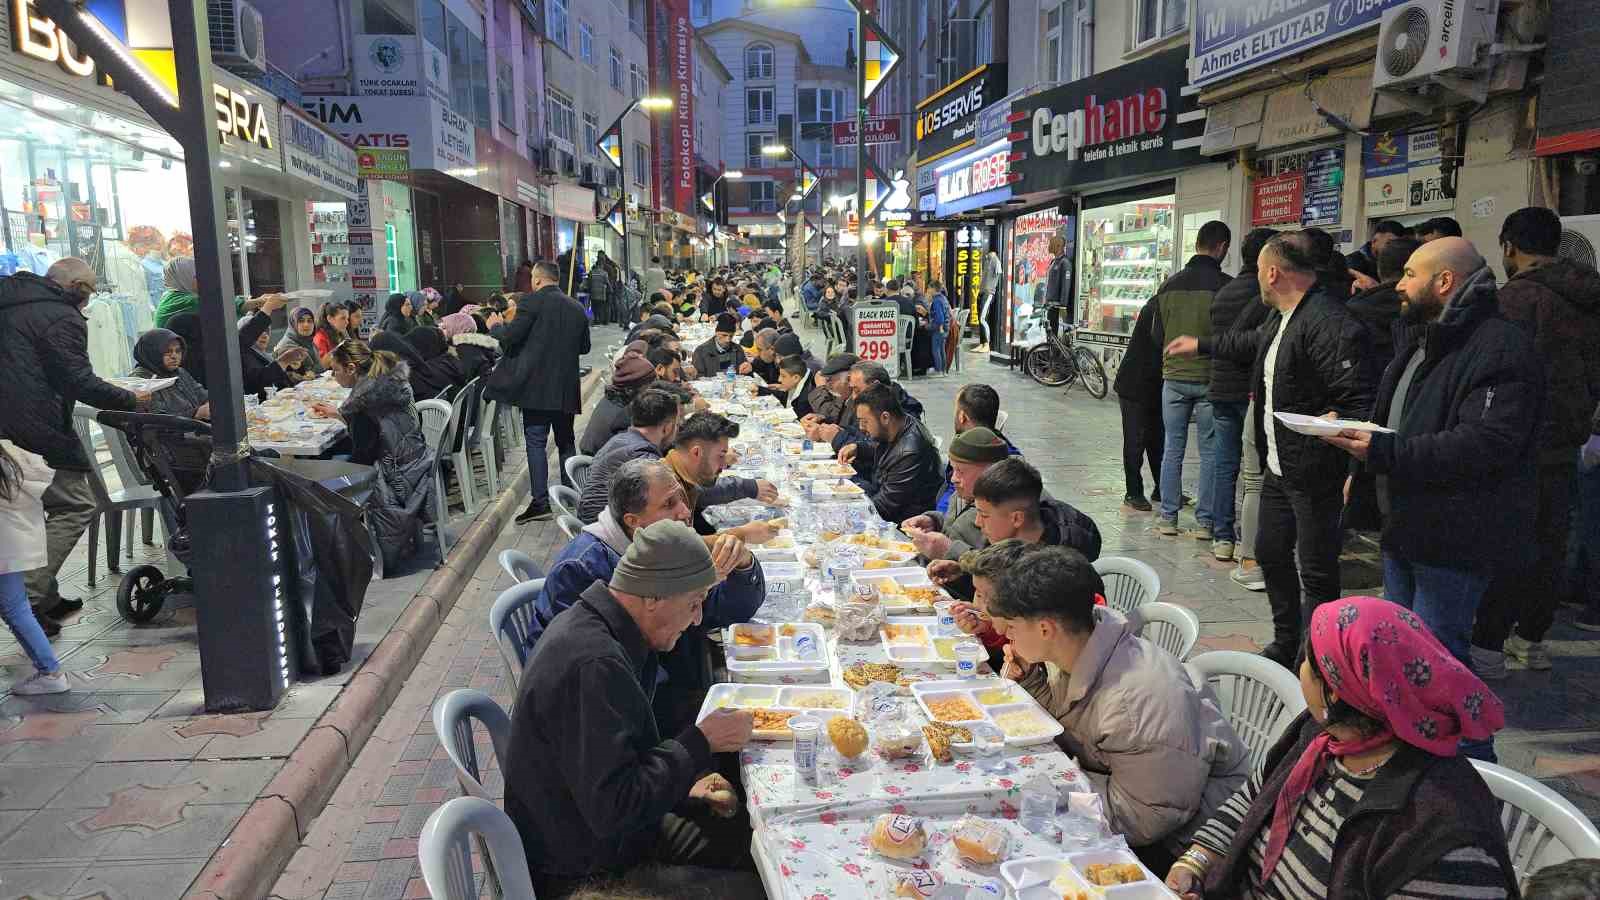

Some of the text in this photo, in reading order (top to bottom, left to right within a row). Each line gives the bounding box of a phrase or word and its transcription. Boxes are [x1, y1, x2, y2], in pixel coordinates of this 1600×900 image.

[1200, 10, 1325, 75] Ahmet ELTUTAR
[441, 107, 468, 133] BURAK
[679, 83, 689, 120] Kitap
[1032, 87, 1167, 161] Cephane
[1084, 136, 1164, 162] telefon & teknik servis
[938, 166, 970, 204] BLACK
[972, 152, 1008, 195] ROSE
[858, 310, 896, 320] BLACK ROSE
